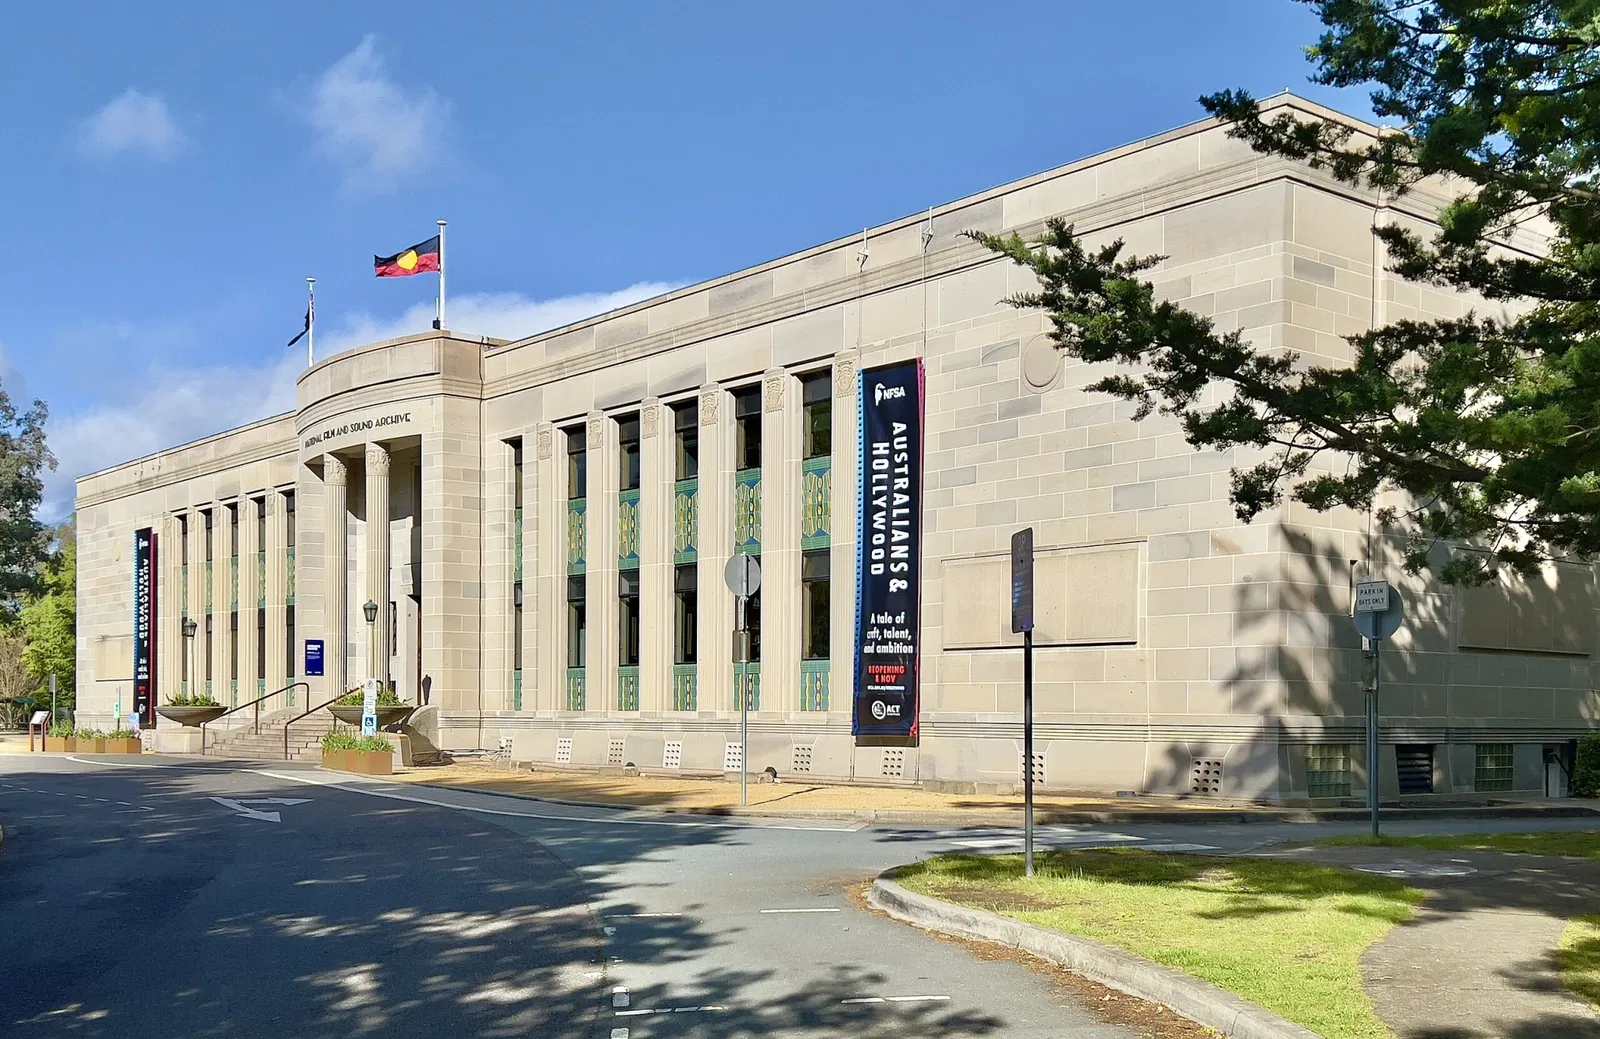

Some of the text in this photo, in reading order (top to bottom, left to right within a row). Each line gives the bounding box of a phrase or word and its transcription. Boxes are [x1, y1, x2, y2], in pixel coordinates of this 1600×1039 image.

[883, 386, 905, 400] NFSA
[337, 426, 348, 436] AND
[350, 420, 373, 432] SOUND
[375, 413, 411, 427] ARCHIVE
[870, 442, 890, 575] HOLLYWOOD
[888, 422, 910, 593] AUSTRALIANS &
[871, 612, 905, 624] A tale of
[884, 627, 911, 640] talent,
[877, 642, 913, 653] ambition
[881, 674, 896, 683] NOV
